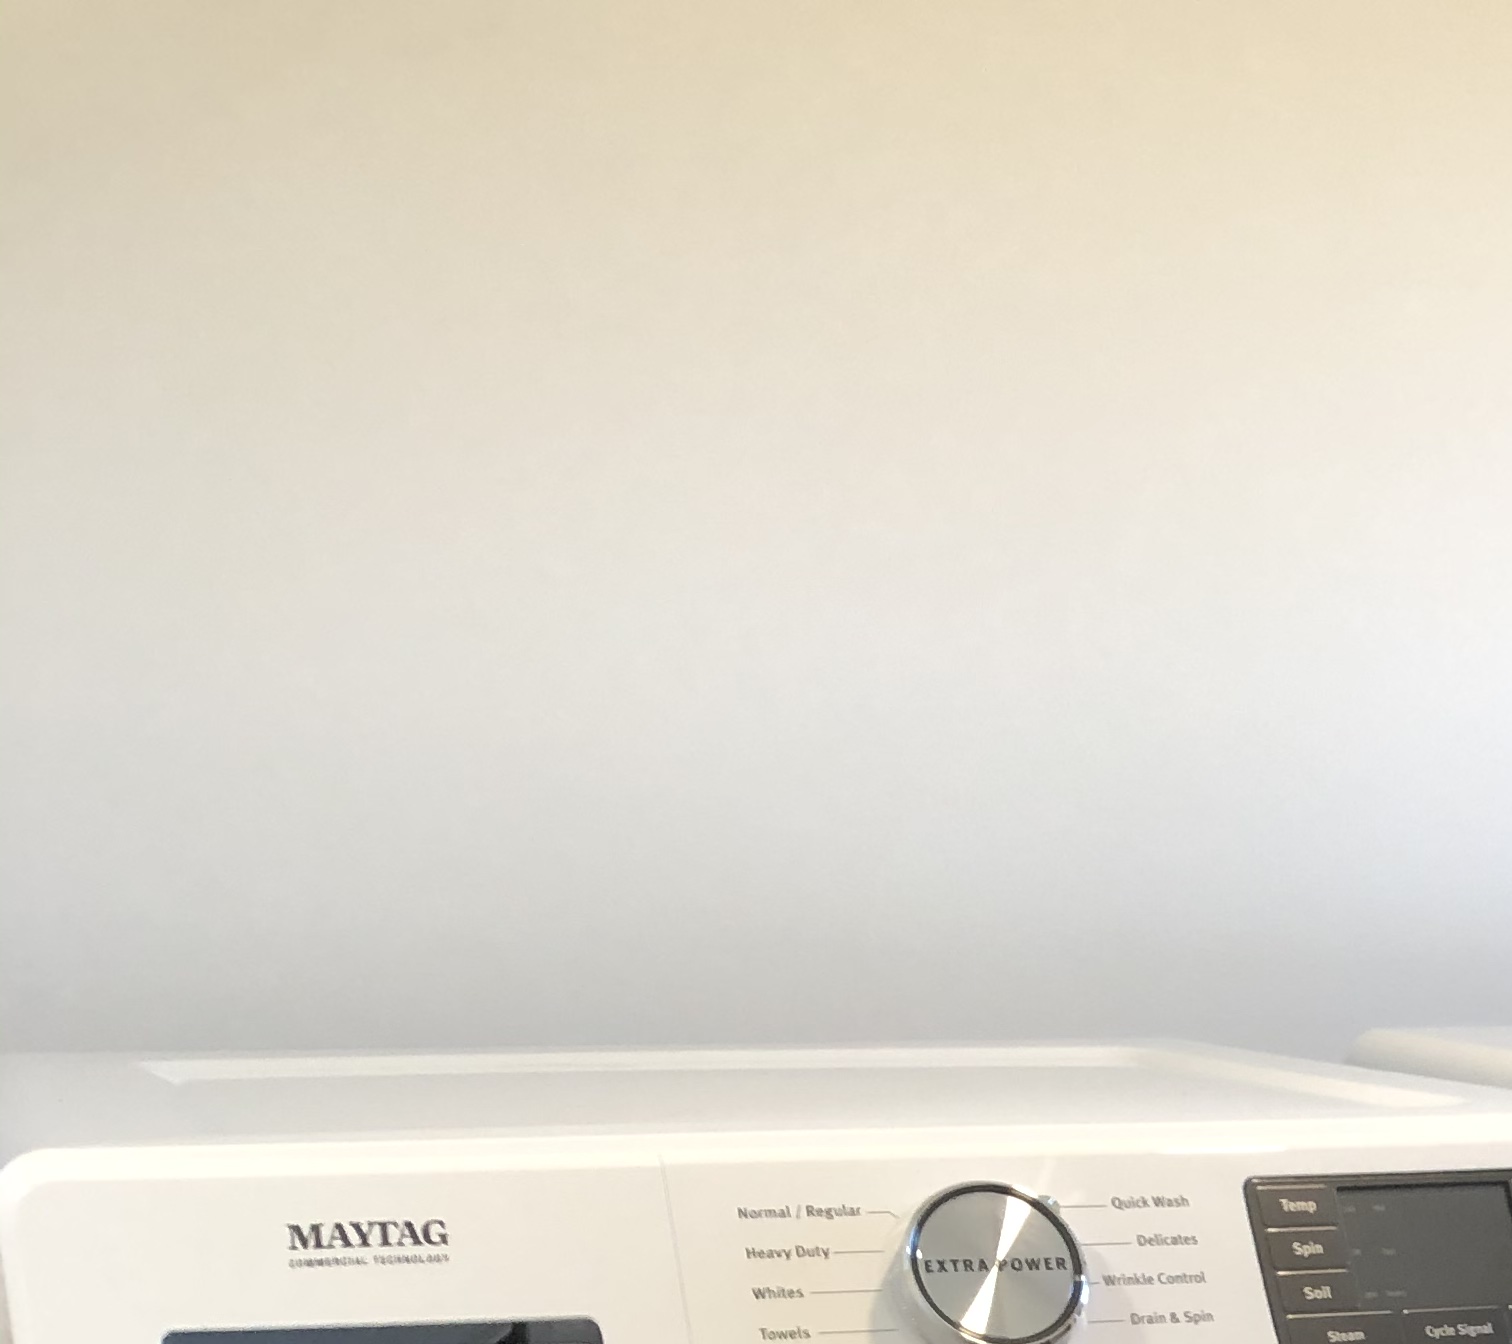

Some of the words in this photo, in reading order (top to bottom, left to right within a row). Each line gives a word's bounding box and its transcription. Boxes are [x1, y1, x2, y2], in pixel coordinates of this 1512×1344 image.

[1111, 1196, 1150, 1211] Quick
[1151, 1195, 1190, 1208] Wash
[1279, 1198, 1317, 1214] Temp
[737, 1205, 791, 1220] Normal
[805, 1205, 861, 1220] Regular
[287, 1219, 449, 1250] MAYTAG
[1136, 1234, 1198, 1247] Delicates
[745, 1247, 791, 1261] Heavy
[795, 1245, 830, 1260] Duty
[1292, 1242, 1324, 1258] Spin
[288, 1256, 368, 1269] COMMERCIAL
[924, 1258, 989, 1273] EXTRA
[997, 1256, 1068, 1272] POWER
[1102, 1273, 1154, 1287] Wrinkle
[1157, 1271, 1207, 1285] Control
[751, 1286, 804, 1300] Whites
[1303, 1286, 1332, 1301] Soil
[1130, 1312, 1167, 1326] Drain
[1169, 1312, 1180, 1324] &
[1183, 1310, 1215, 1326] Spin
[758, 1326, 811, 1340] Towels
[1327, 1330, 1366, 1343] Steam
[1425, 1324, 1456, 1340] Cycle
[1456, 1321, 1495, 1338] Signal
